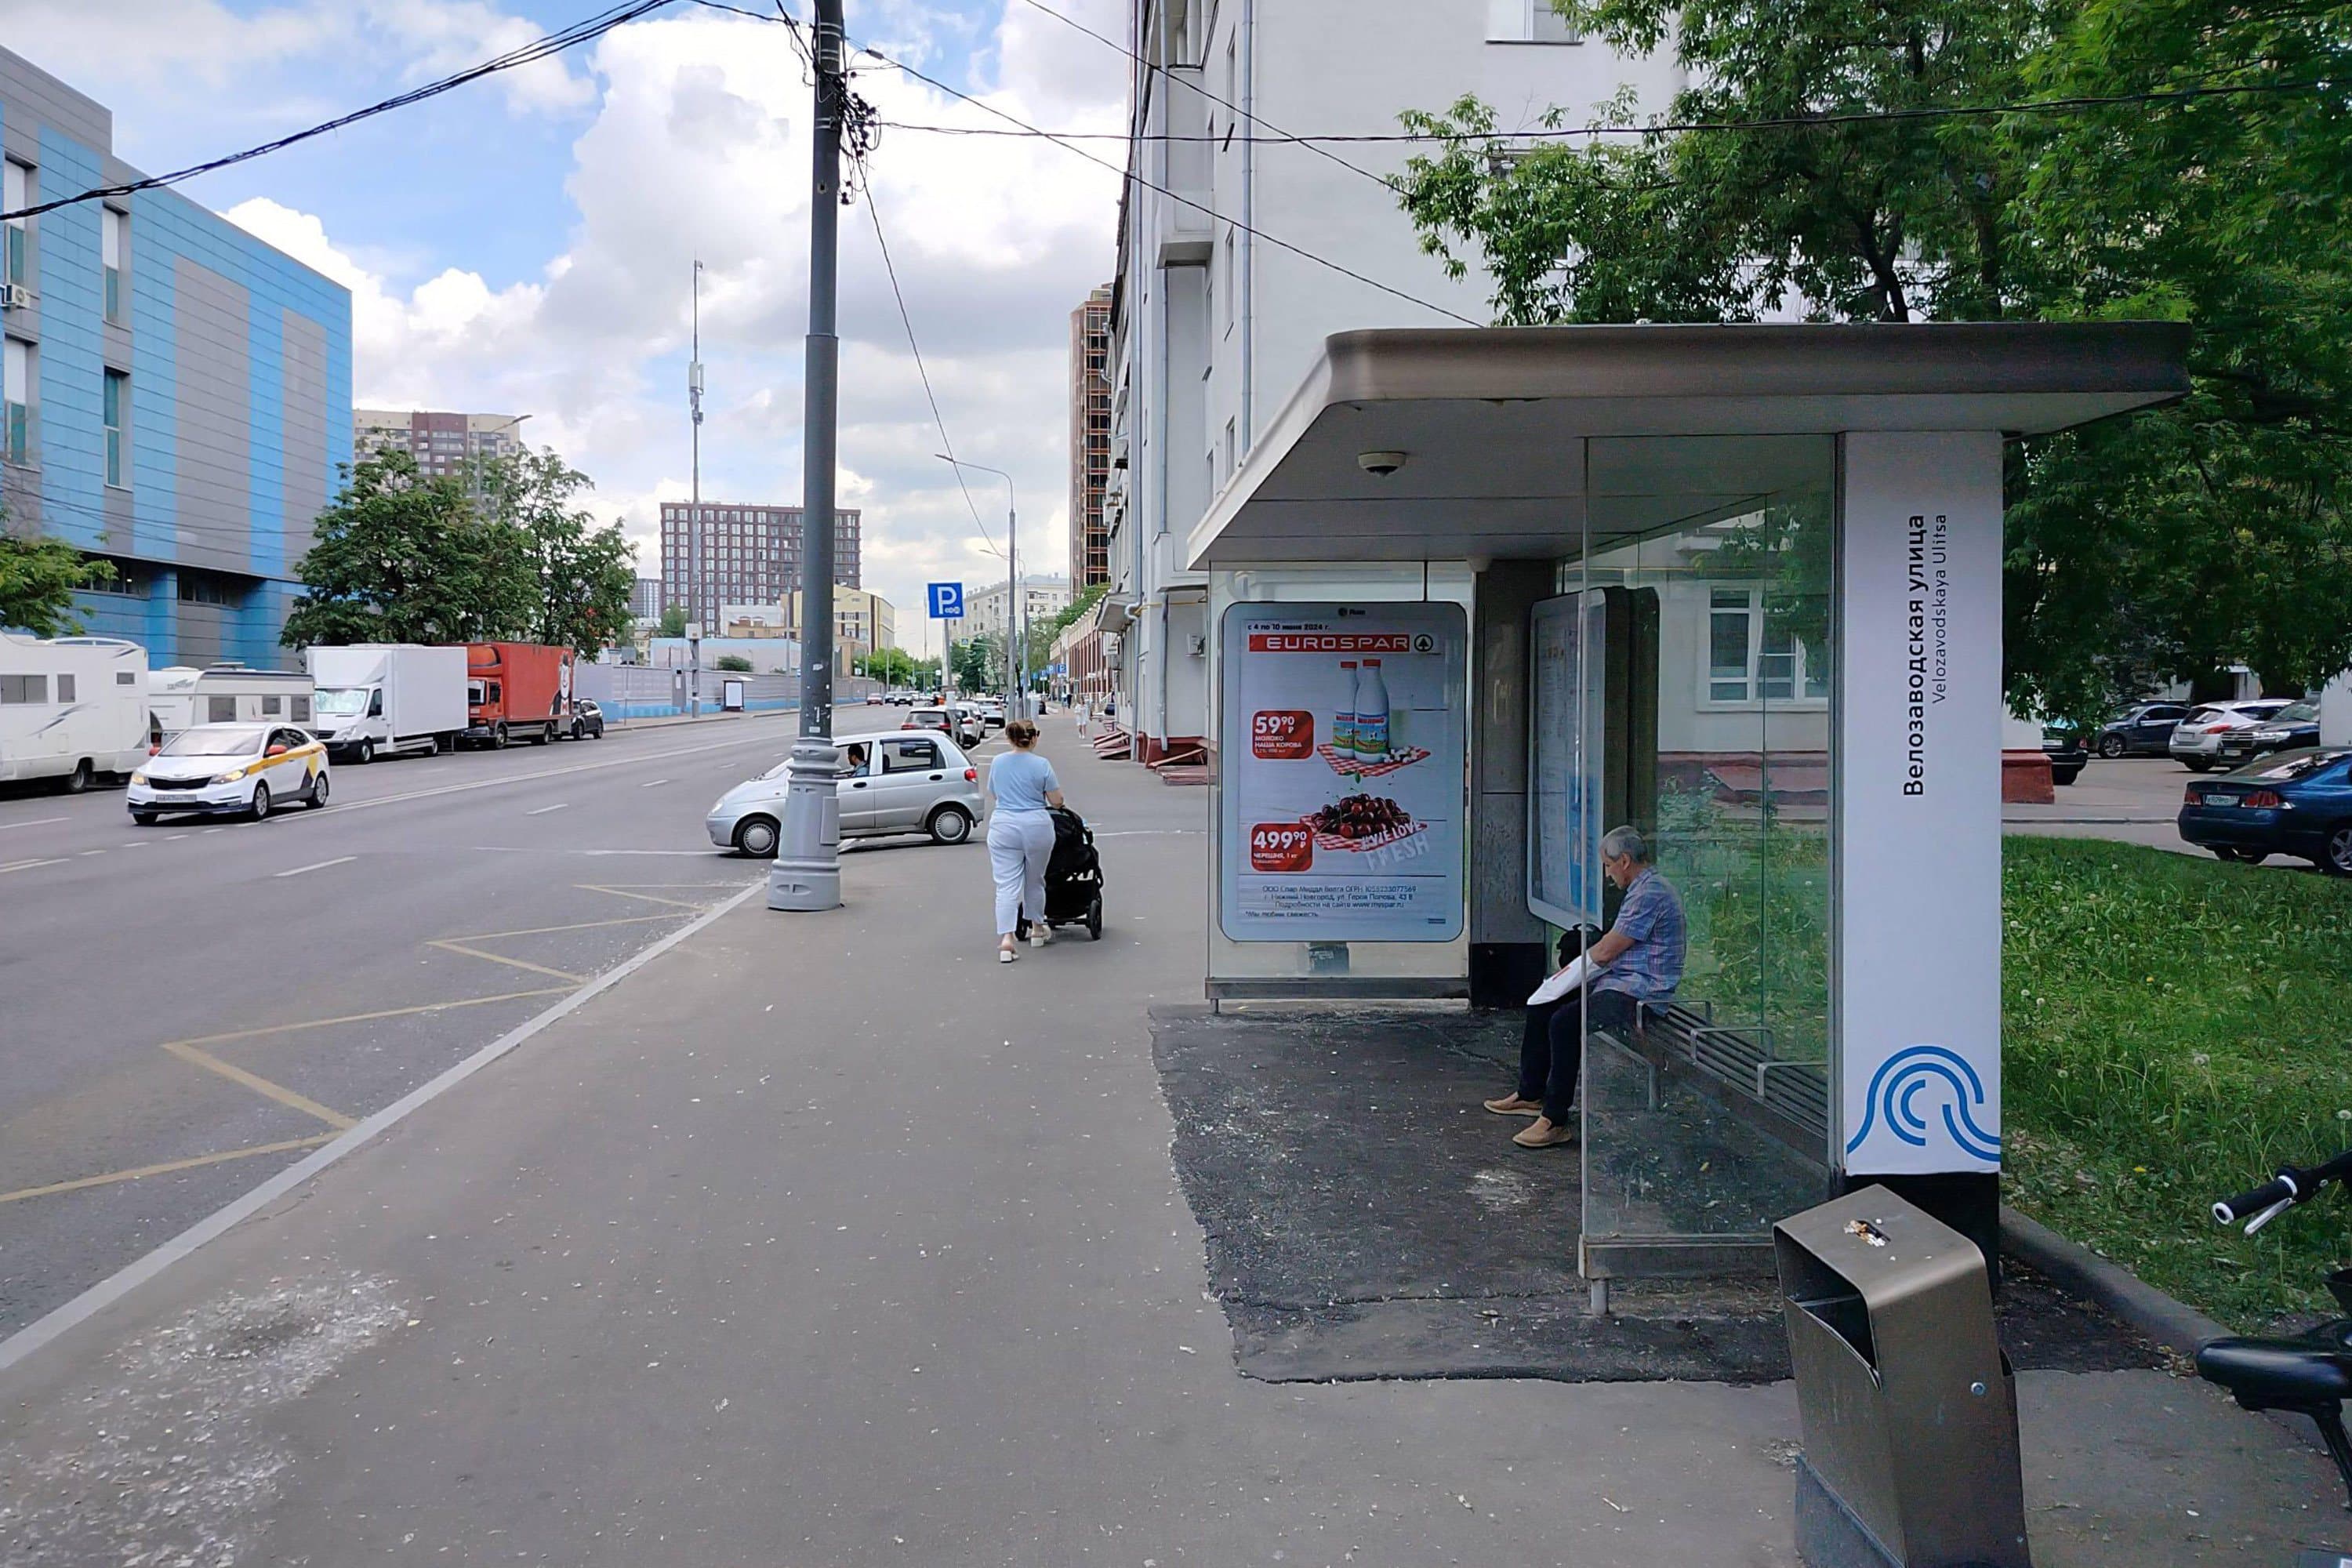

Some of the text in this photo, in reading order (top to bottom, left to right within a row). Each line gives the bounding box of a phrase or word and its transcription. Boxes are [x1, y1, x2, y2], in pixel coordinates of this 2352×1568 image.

[1266, 637, 1408, 649] EUROSPAR
[1904, 514, 1929, 796] Велозаводская улица
[1931, 514, 1949, 703] Velozavodskaya Ulitsa
[1366, 833, 1430, 871] FRESH
